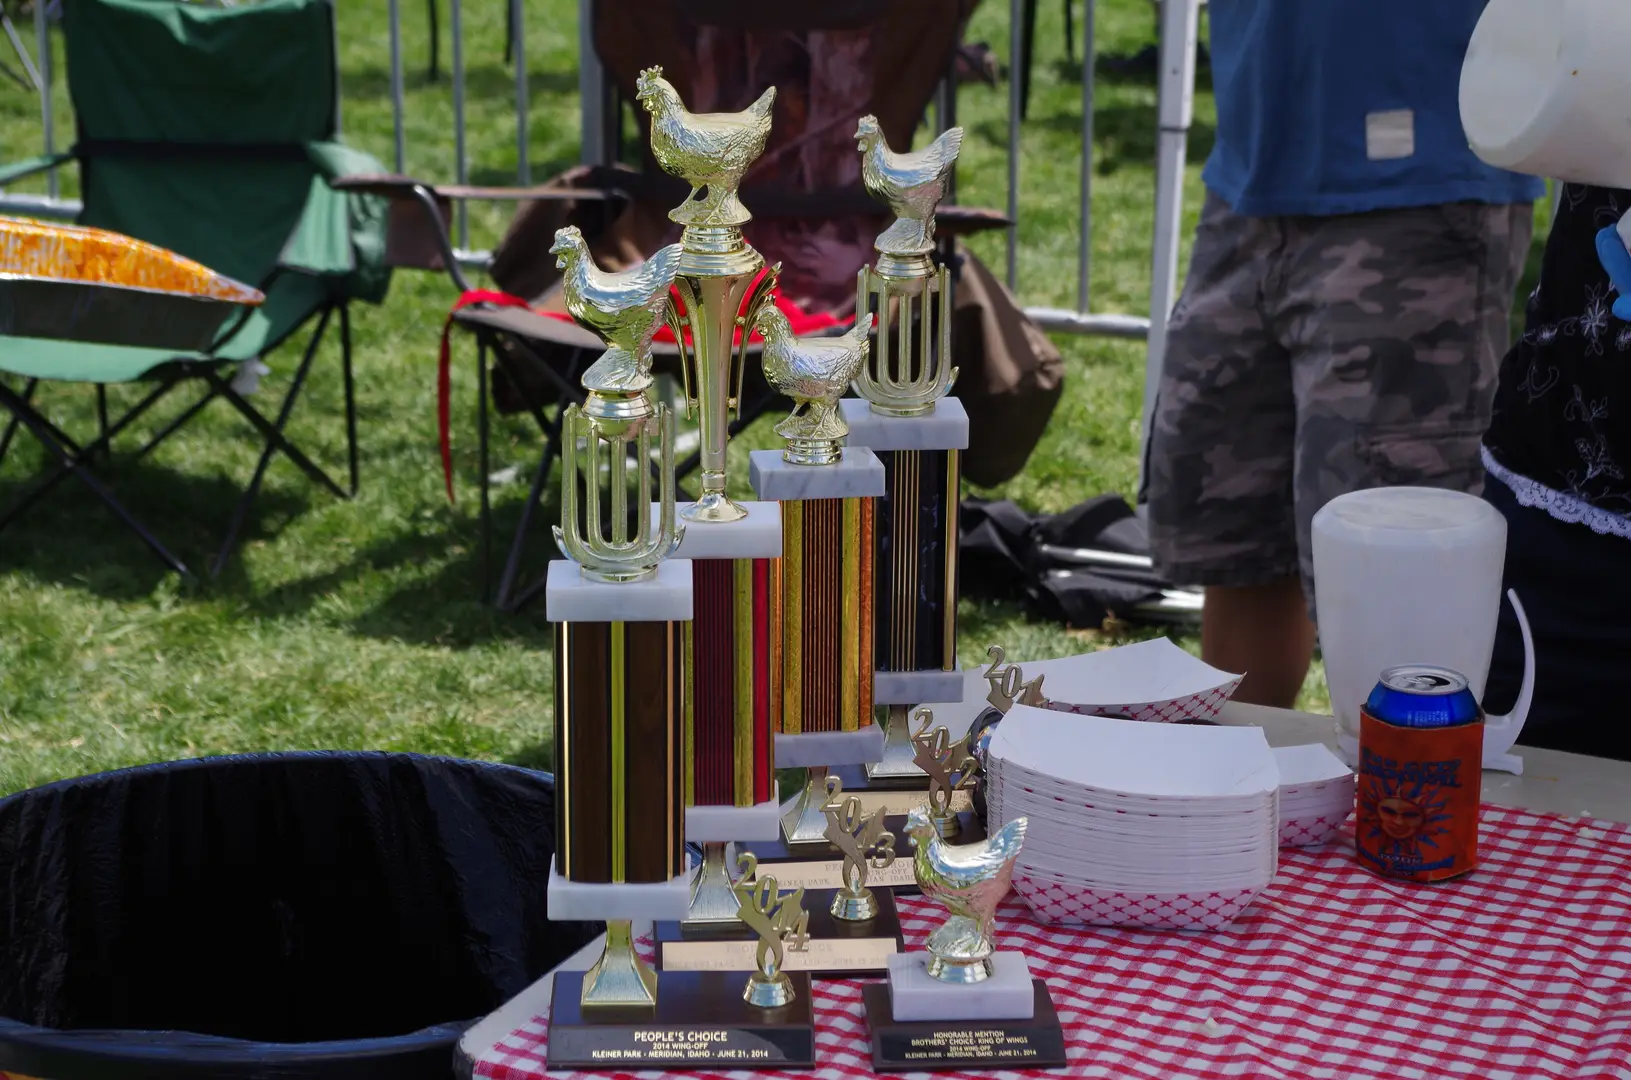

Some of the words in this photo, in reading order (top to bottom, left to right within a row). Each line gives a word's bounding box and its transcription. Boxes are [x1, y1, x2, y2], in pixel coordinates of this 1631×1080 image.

[983, 645, 1050, 707] 201
[911, 707, 977, 789] 2012
[819, 775, 896, 868] 2013
[733, 852, 810, 952] 2014
[634, 1031, 685, 1042] PEOPLE'S
[687, 1031, 728, 1042] CHOICE
[933, 1031, 973, 1039] HONORABLE
[974, 1030, 1005, 1038] MENTION
[652, 1042, 670, 1050] 2014
[671, 1042, 709, 1050] WING-OFF
[911, 1038, 948, 1046] BROTHERS'
[978, 1037, 994, 1045] KING
[1006, 1036, 1028, 1044] WINGS
[592, 1050, 622, 1058] KLEINER
[623, 1050, 642, 1058] PARK
[648, 1050, 685, 1059] MERIDIAN,
[687, 1050, 710, 1058] IDAHO
[717, 1050, 736, 1058] JUNE
[737, 1050, 749, 1058] 21,
[998, 1049, 1012, 1057] JUNE
